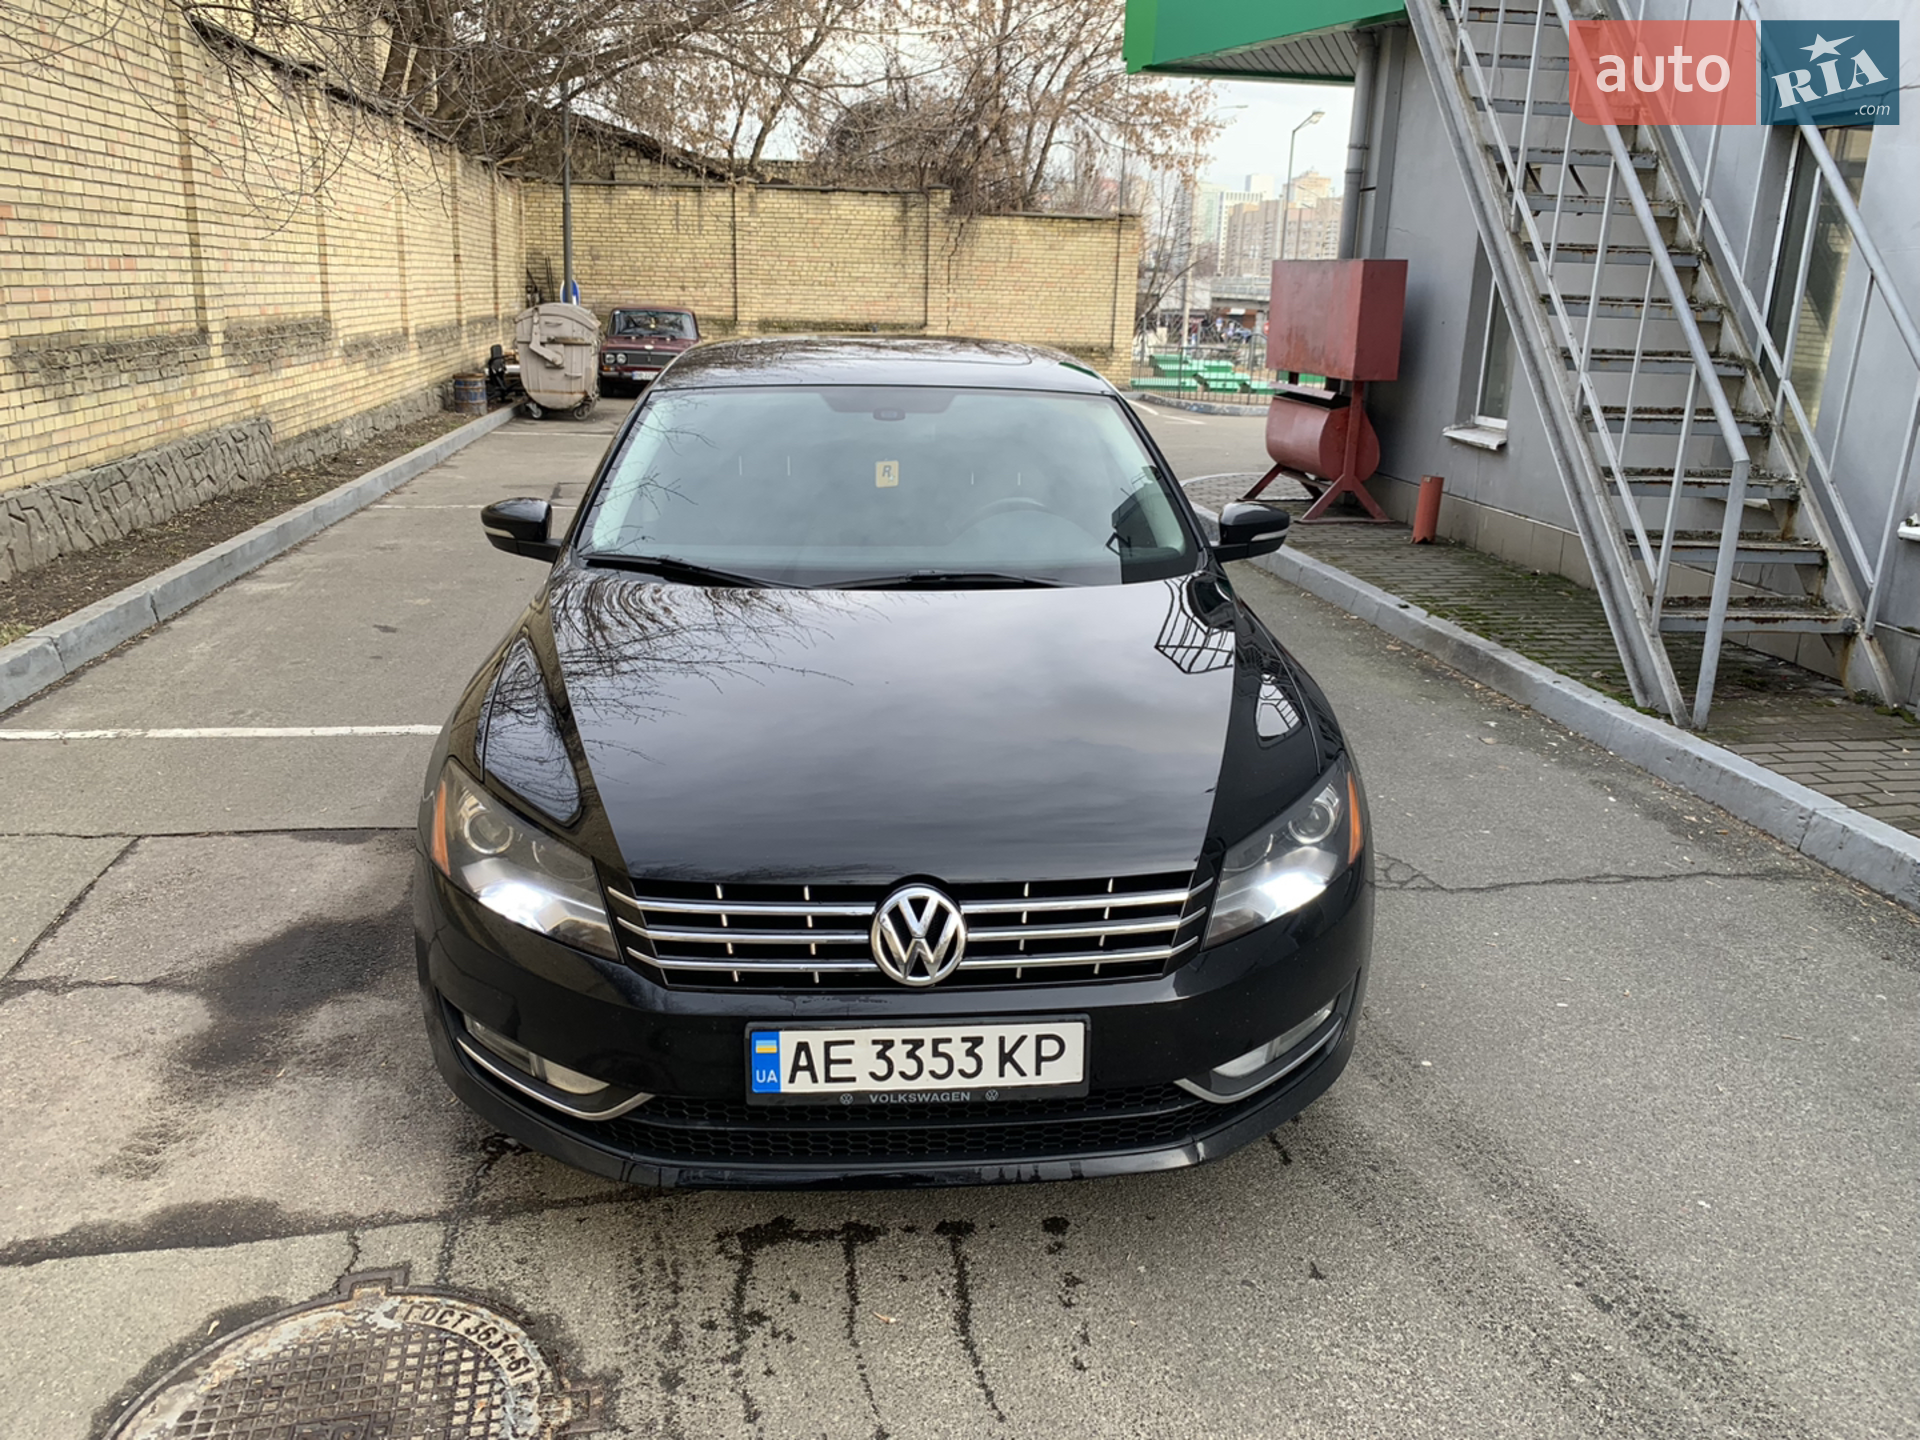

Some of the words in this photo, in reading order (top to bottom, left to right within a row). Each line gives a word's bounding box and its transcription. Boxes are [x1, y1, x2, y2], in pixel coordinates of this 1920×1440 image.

[788, 1039, 857, 1084] AE
[868, 1035, 985, 1082] 3353
[998, 1033, 1067, 1079] KP
[756, 1068, 778, 1084] UA
[869, 1091, 971, 1104] VOLKSWAGEN
